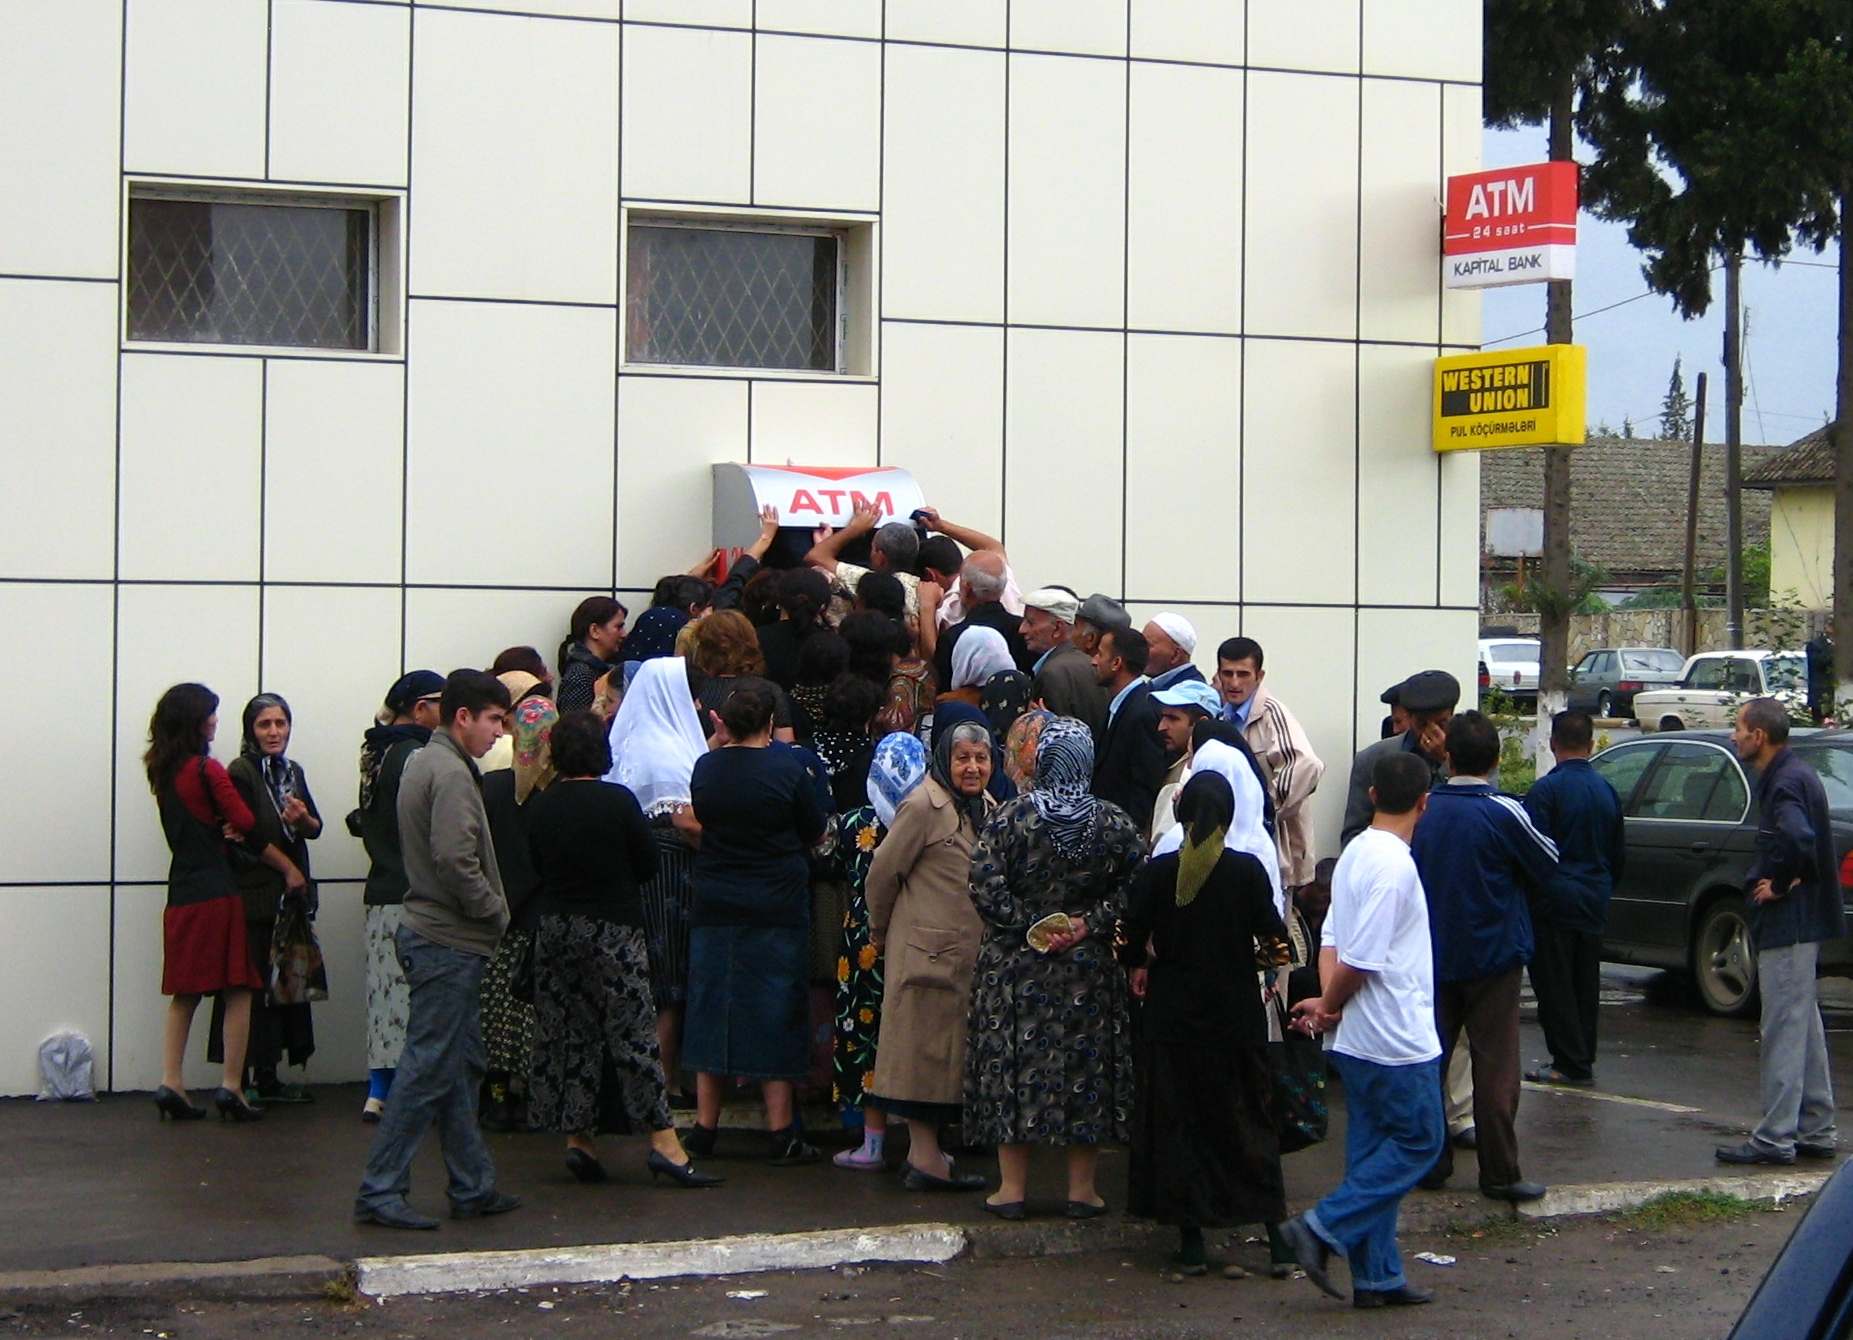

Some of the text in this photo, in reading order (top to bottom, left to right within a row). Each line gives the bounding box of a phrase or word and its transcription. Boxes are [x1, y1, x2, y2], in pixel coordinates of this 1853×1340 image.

[1465, 176, 1534, 220] ATM
[1472, 223, 1526, 239] 24 saat
[1508, 254, 1541, 270] BANK
[1443, 365, 1529, 392] WESTERN
[1469, 388, 1529, 413] UNION
[1450, 426, 1468, 437] PUL
[789, 489, 894, 516] ATM
